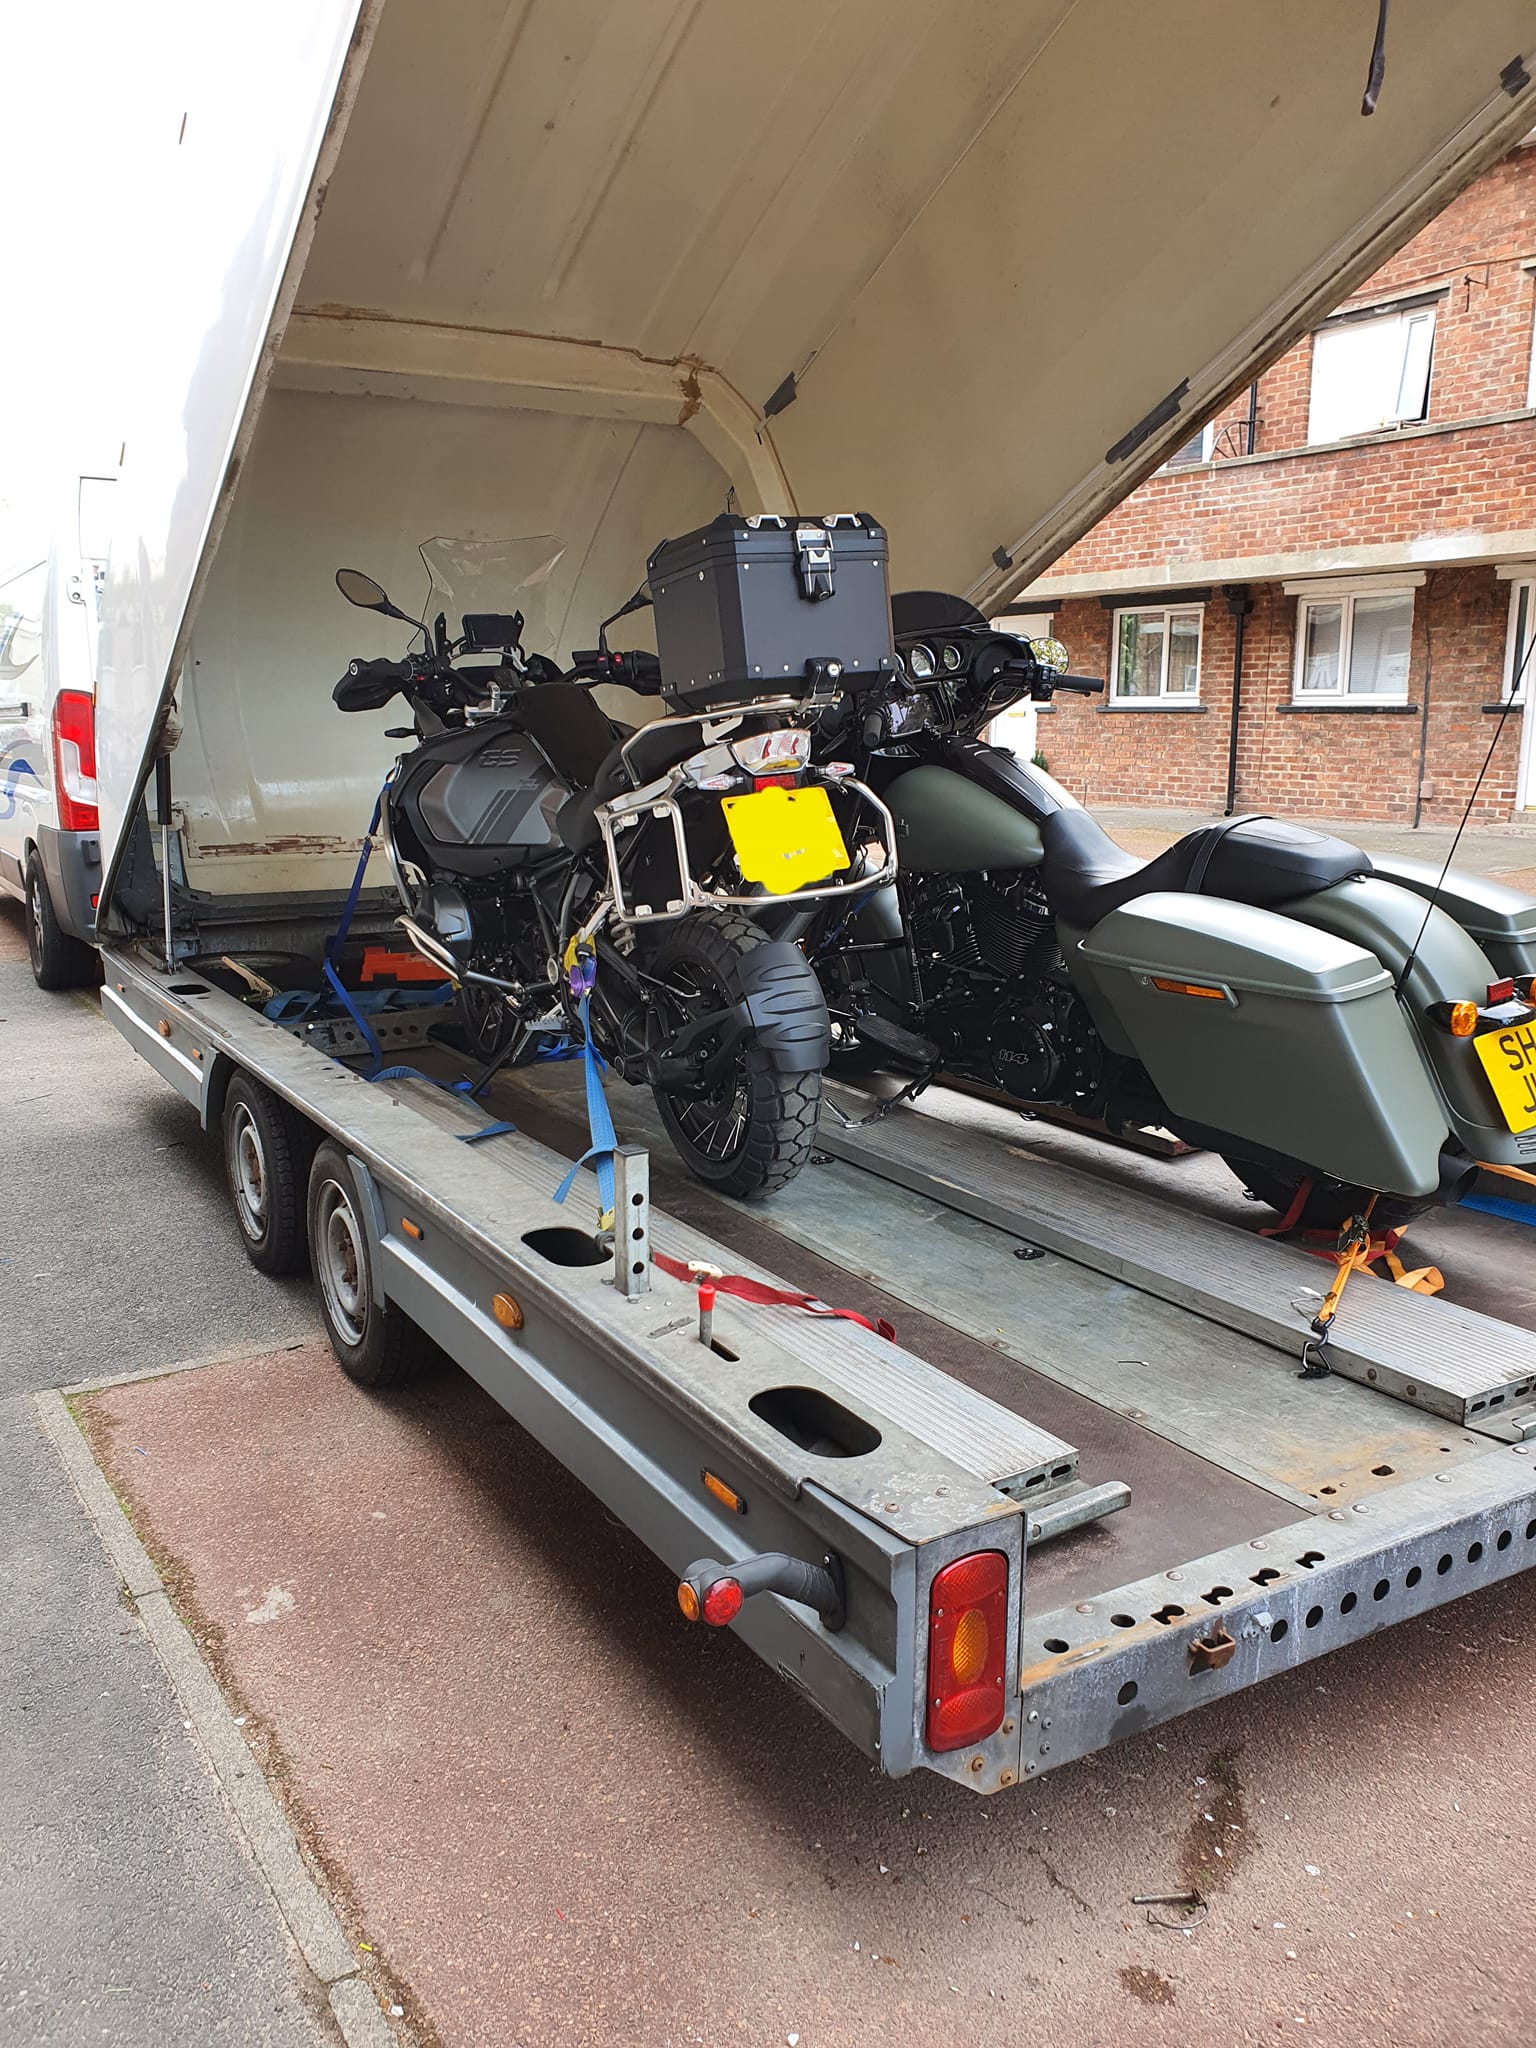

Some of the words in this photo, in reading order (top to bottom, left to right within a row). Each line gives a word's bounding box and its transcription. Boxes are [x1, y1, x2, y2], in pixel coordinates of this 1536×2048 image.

[480, 749, 521, 768] GS
[999, 1049, 1029, 1064] 114
[1523, 1072, 1536, 1113] J
